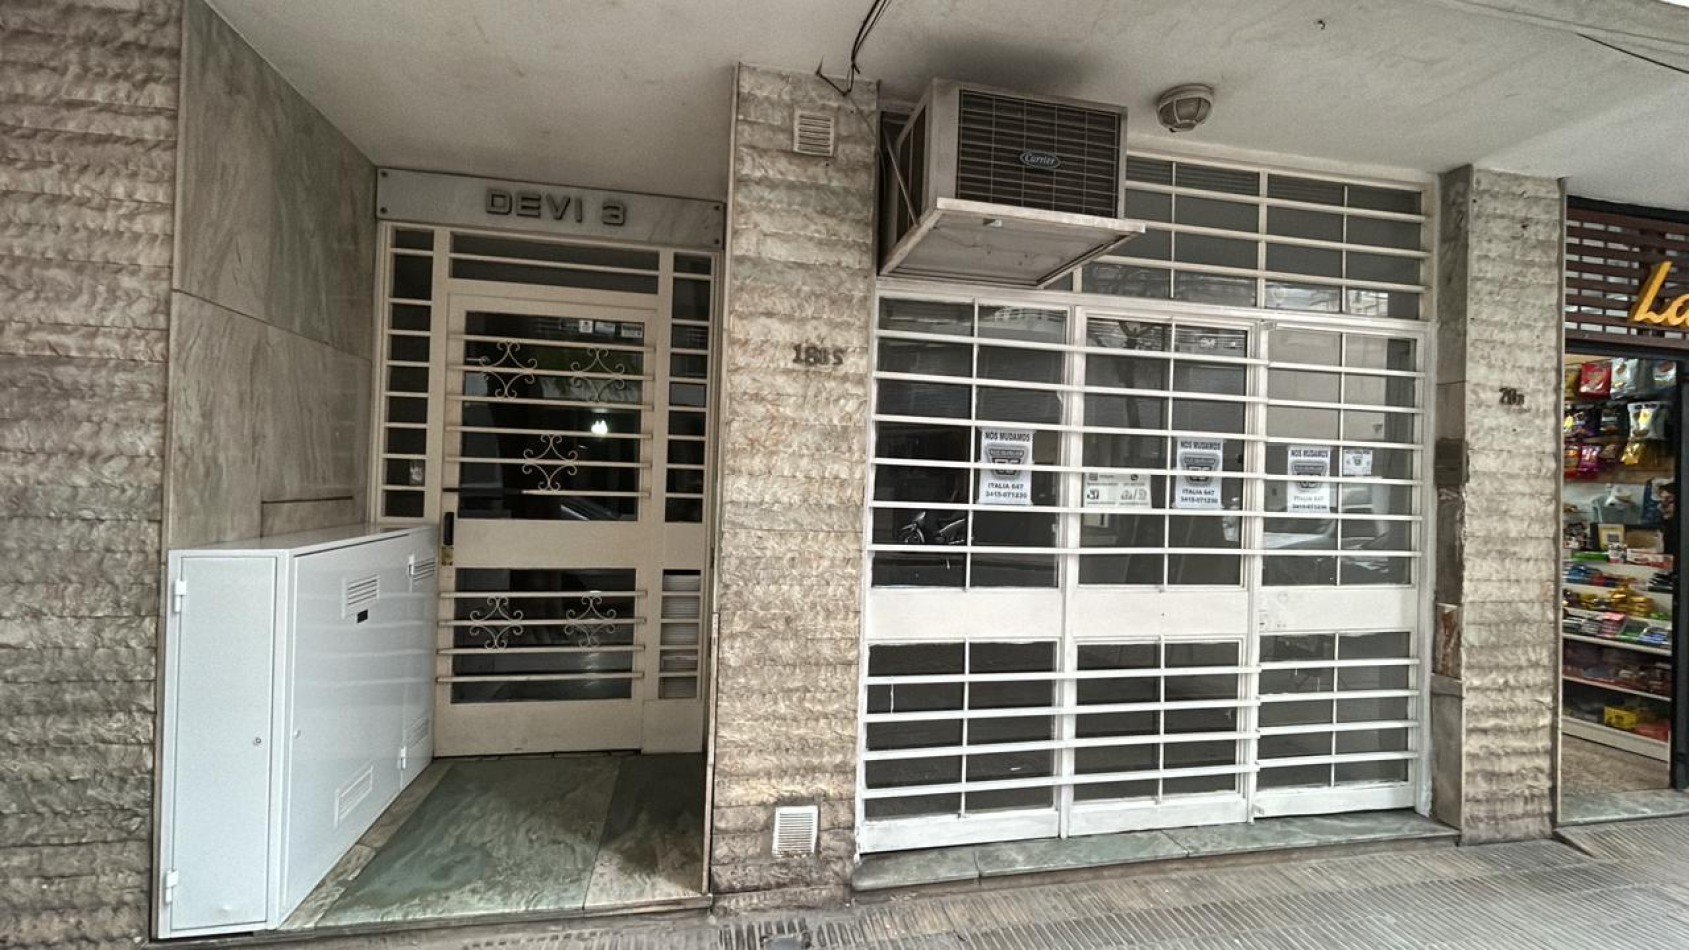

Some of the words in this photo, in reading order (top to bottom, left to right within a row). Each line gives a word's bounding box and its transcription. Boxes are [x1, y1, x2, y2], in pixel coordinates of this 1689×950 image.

[1023, 152, 1056, 165] Carrier
[486, 188, 583, 223] DEVI
[602, 200, 626, 227] 3
[985, 432, 998, 440] NOS
[1000, 433, 1030, 442] MUDAMOS
[1180, 440, 1192, 449] NOS
